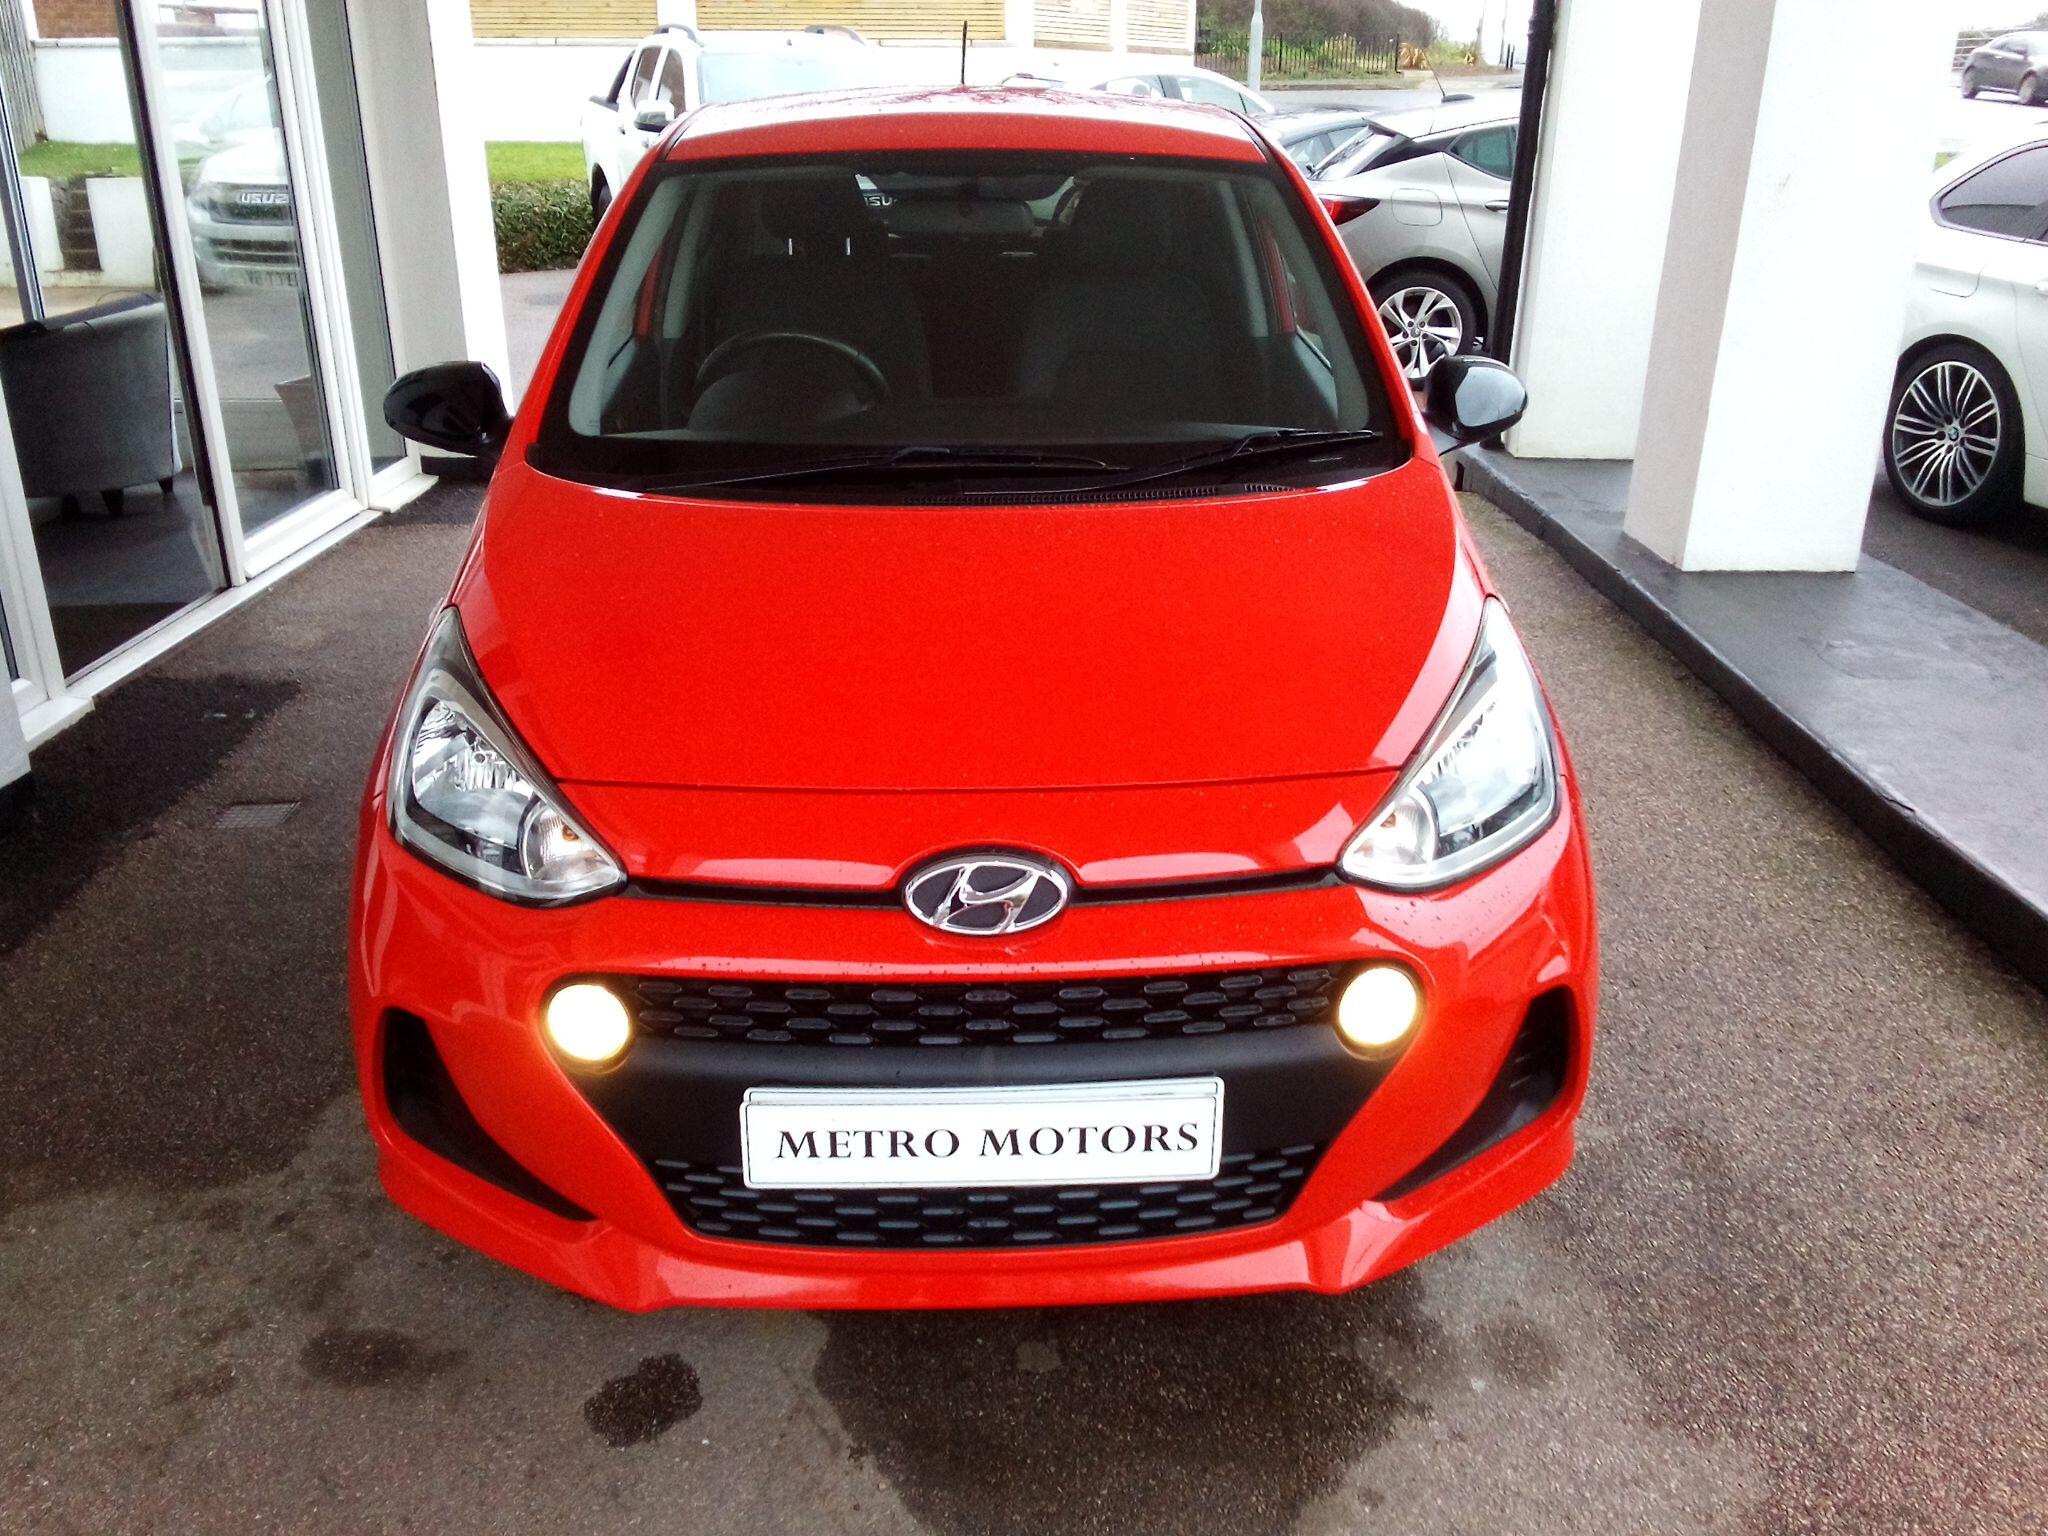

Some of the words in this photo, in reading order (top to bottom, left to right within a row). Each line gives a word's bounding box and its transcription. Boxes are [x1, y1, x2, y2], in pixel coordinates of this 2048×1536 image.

[864, 195, 897, 207] ISU
[775, 1128, 960, 1159] METRO
[979, 1121, 1199, 1157] MOTORS
